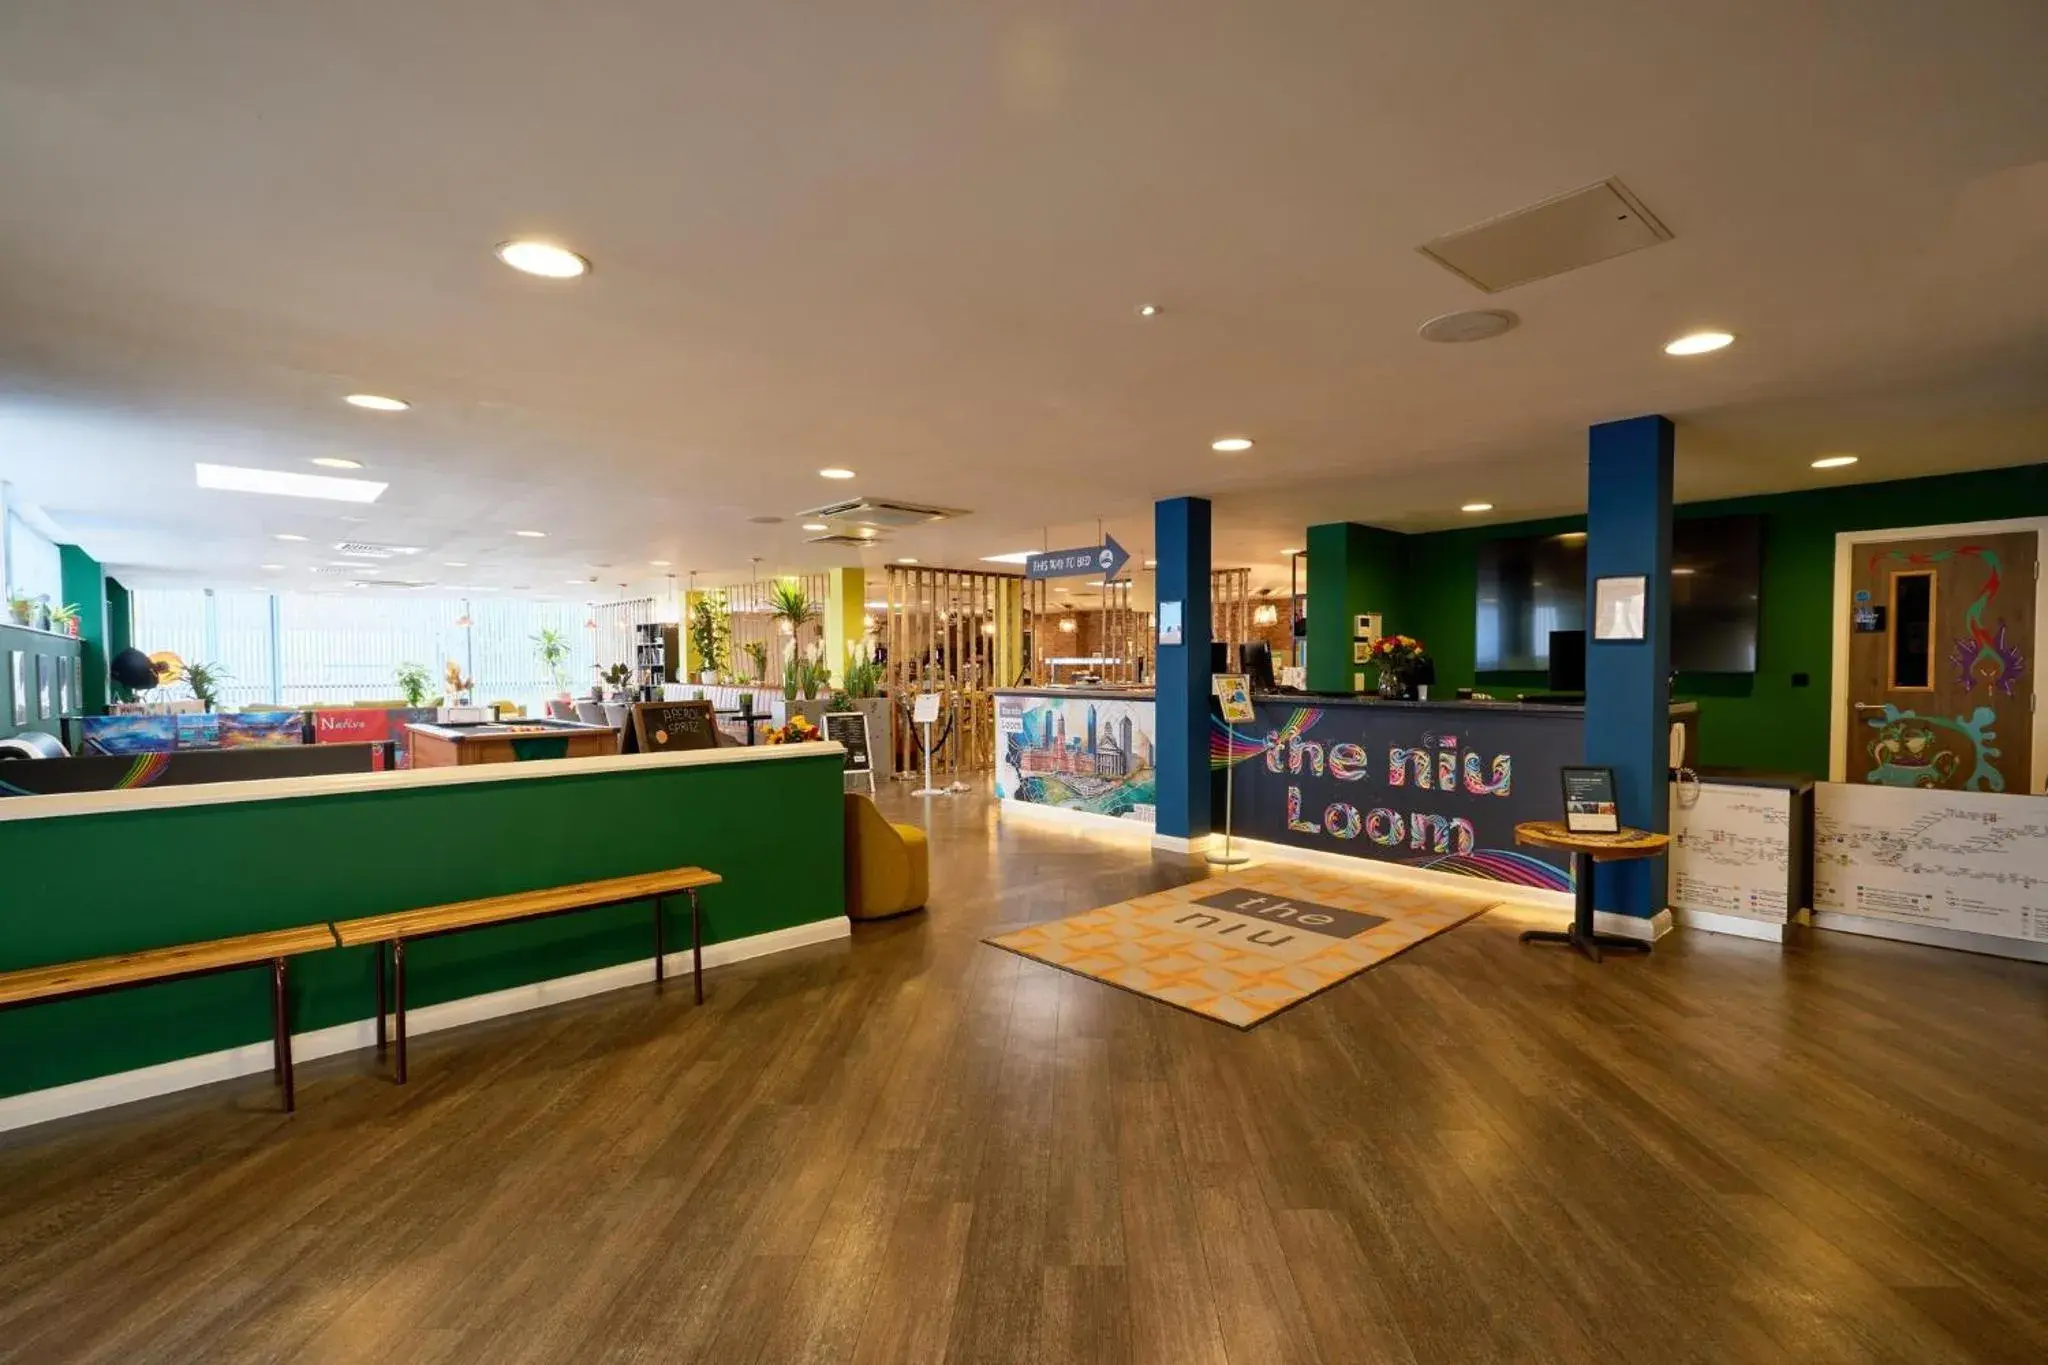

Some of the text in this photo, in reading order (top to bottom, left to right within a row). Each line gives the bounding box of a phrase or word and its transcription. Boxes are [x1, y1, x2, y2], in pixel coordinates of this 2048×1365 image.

[1077, 554, 1092, 567] BED
[1264, 729, 1512, 797] the niu
[1287, 785, 1475, 857] Loom
[1235, 897, 1335, 925] the
[1173, 912, 1296, 949] niu
